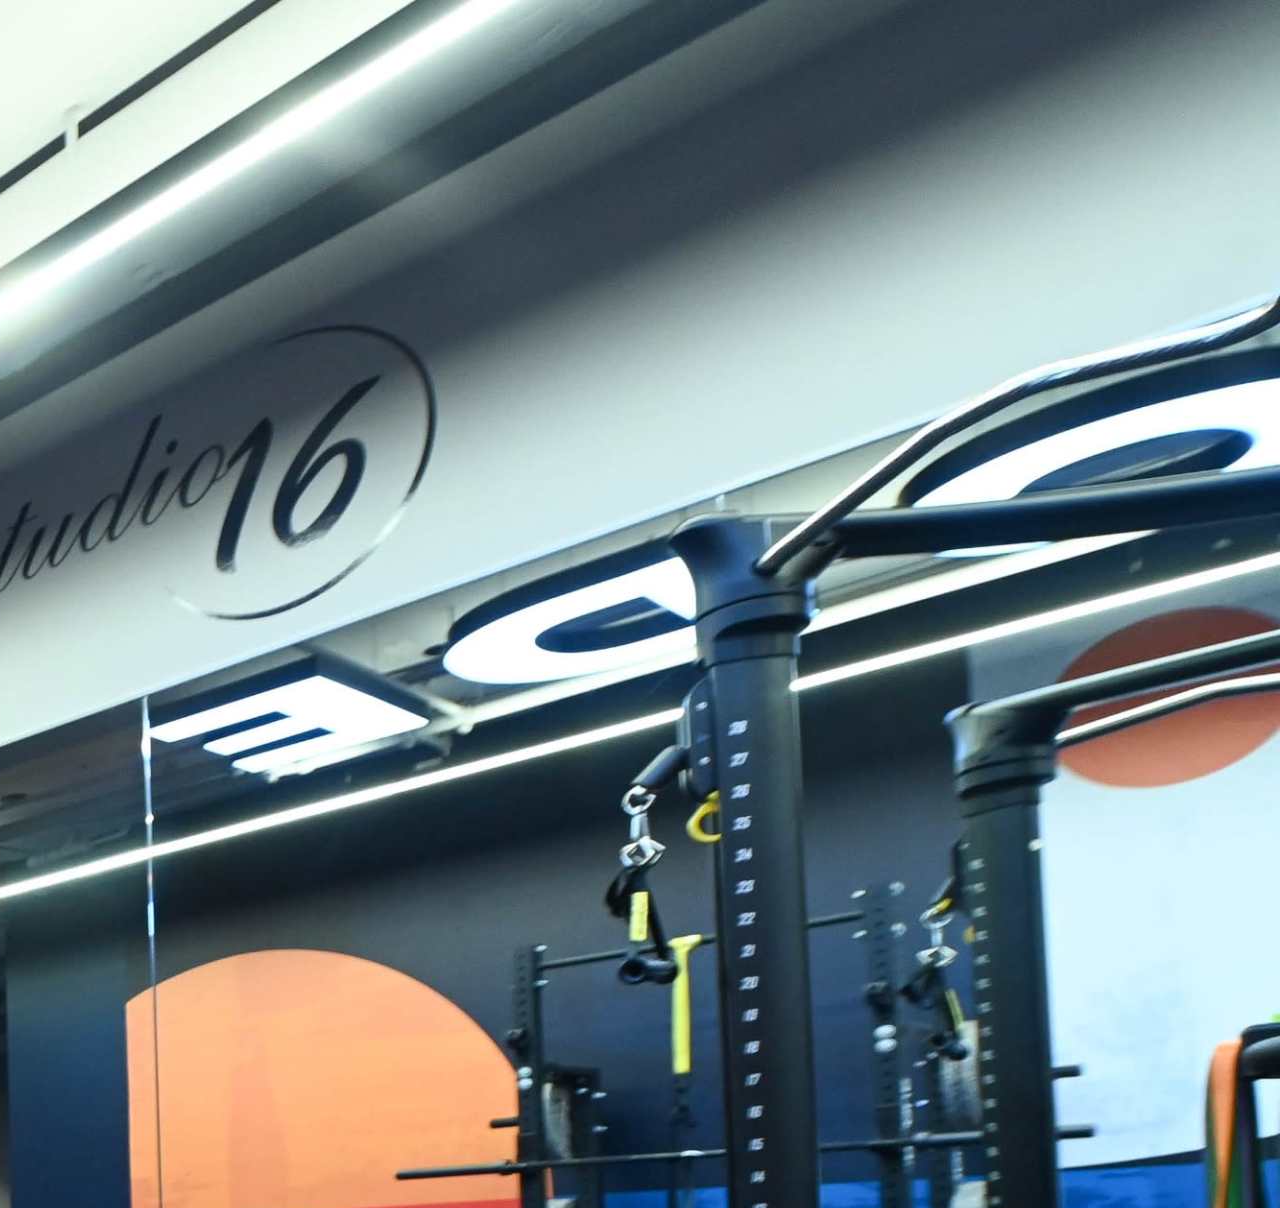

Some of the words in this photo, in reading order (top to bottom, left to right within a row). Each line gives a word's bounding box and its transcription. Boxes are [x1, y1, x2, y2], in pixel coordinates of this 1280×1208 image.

[216, 376, 382, 573] 16
[728, 720, 748, 735] 28
[730, 752, 749, 767] 27
[731, 784, 750, 799] 26
[733, 816, 751, 830] 25
[735, 848, 752, 862] 24
[736, 880, 755, 894] 23
[738, 912, 756, 926] 22
[741, 944, 755, 957] 21
[740, 976, 759, 990] 20
[744, 1009, 758, 1021] 19
[745, 1041, 760, 1053] 18
[746, 1073, 761, 1085] 17
[748, 1106, 763, 1118] 16
[750, 1138, 763, 1150] 15
[752, 1171, 765, 1182] 14
